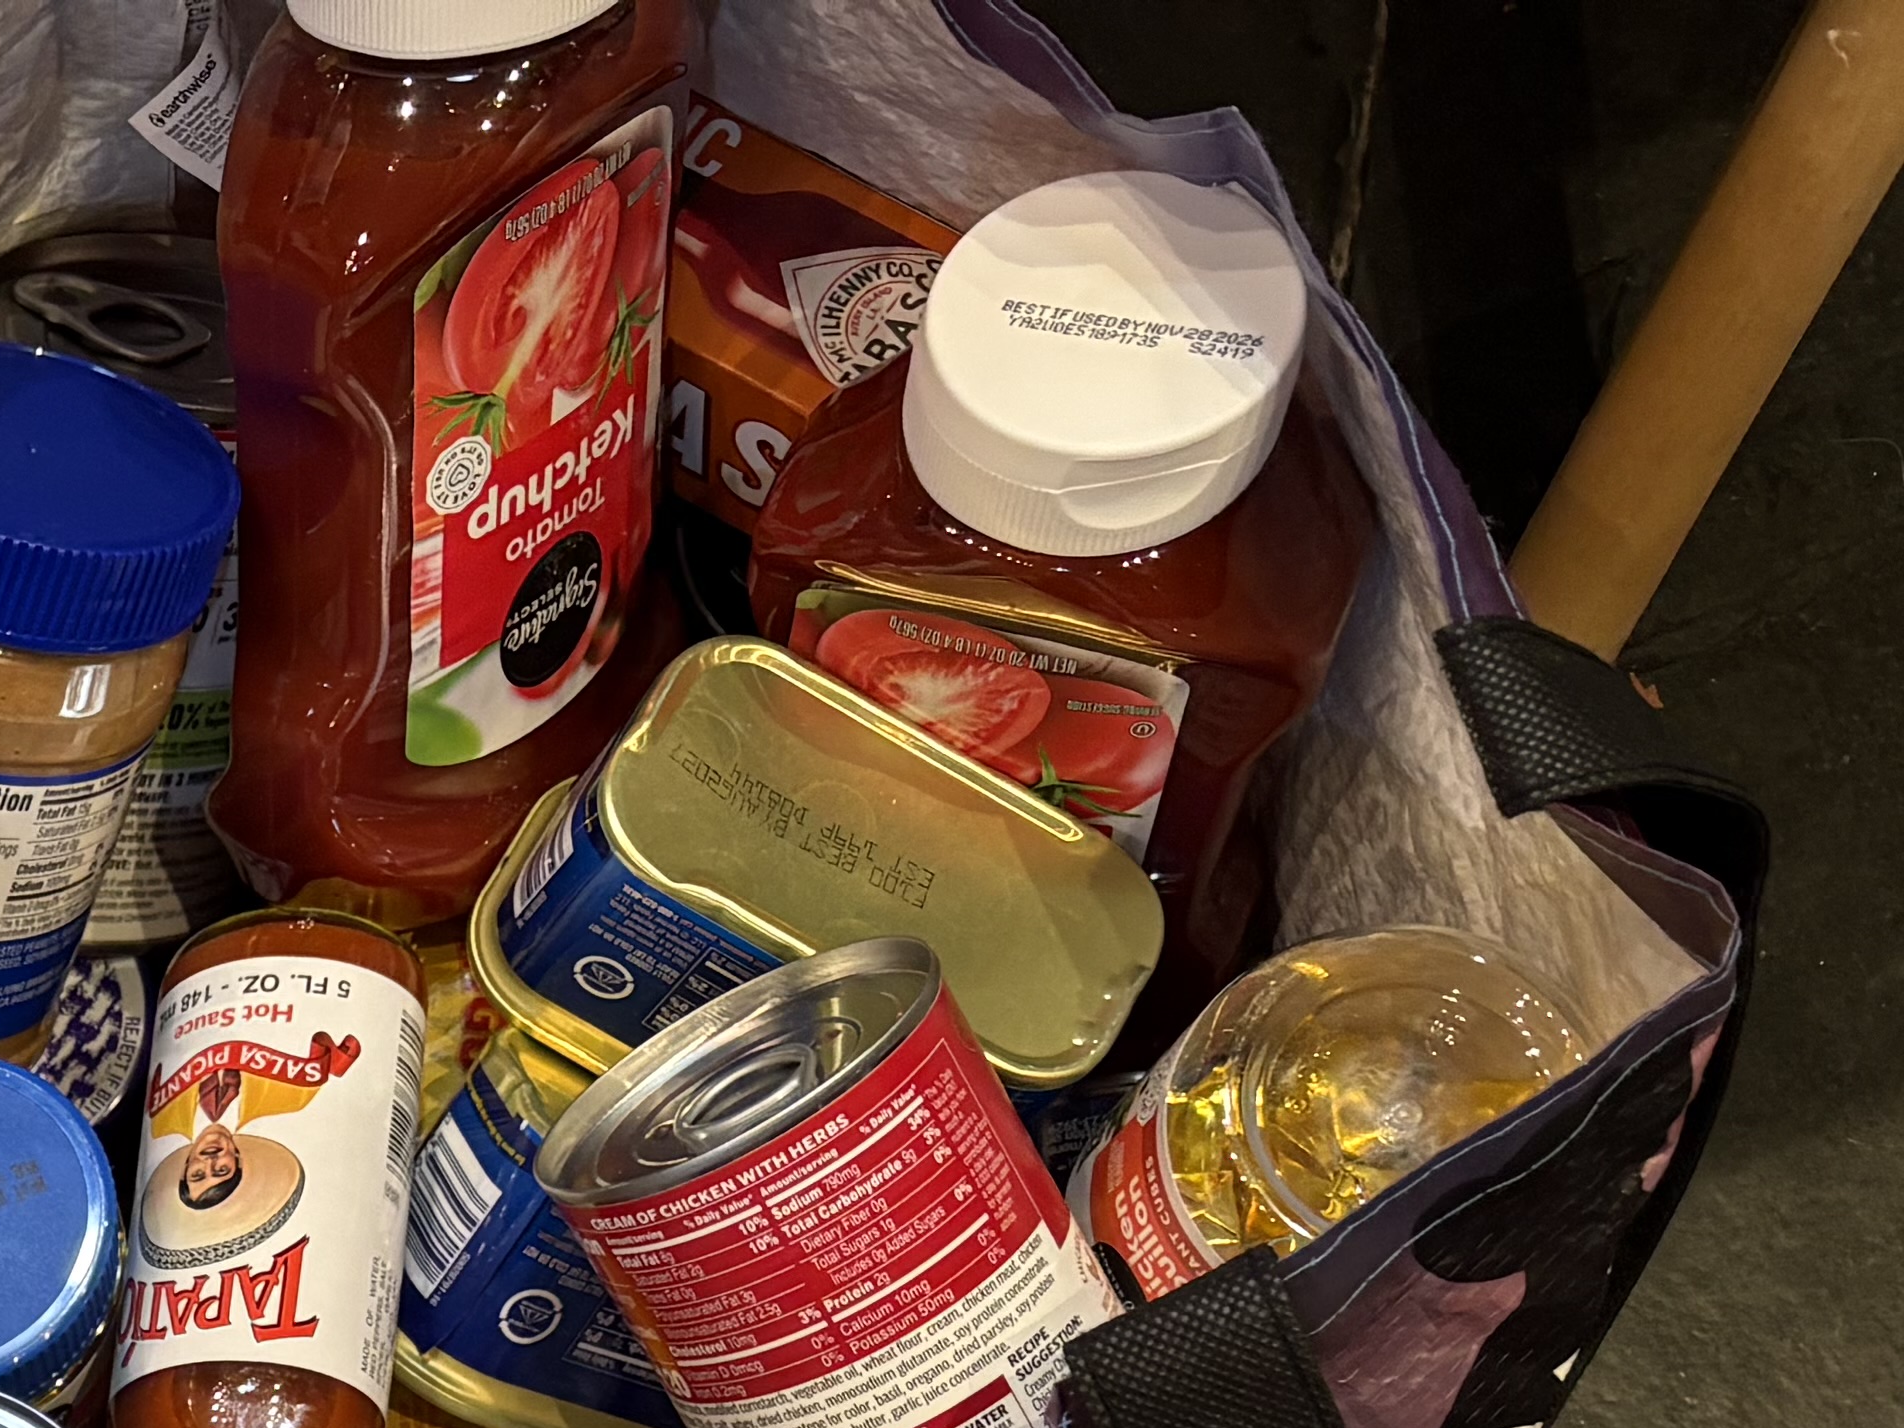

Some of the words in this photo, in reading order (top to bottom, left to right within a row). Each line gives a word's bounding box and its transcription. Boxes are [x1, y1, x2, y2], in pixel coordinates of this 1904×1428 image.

[467, 394, 635, 539] Ketchup
[506, 477, 605, 562] Tomato
[503, 562, 598, 651] Signature
[238, 974, 281, 993] OZ.
[290, 974, 328, 995] FL.
[338, 978, 351, 998] 5
[174, 1008, 236, 1038] Sauce
[240, 1004, 294, 1023] Hot
[591, 1211, 635, 1232] CREAM
[636, 1208, 659, 1224] OF
[659, 1175, 739, 1220] CHICKEN
[736, 1152, 791, 1188] WITH
[789, 1112, 851, 1159] HERBS
[1007, 1326, 1049, 1367] RECIPE
